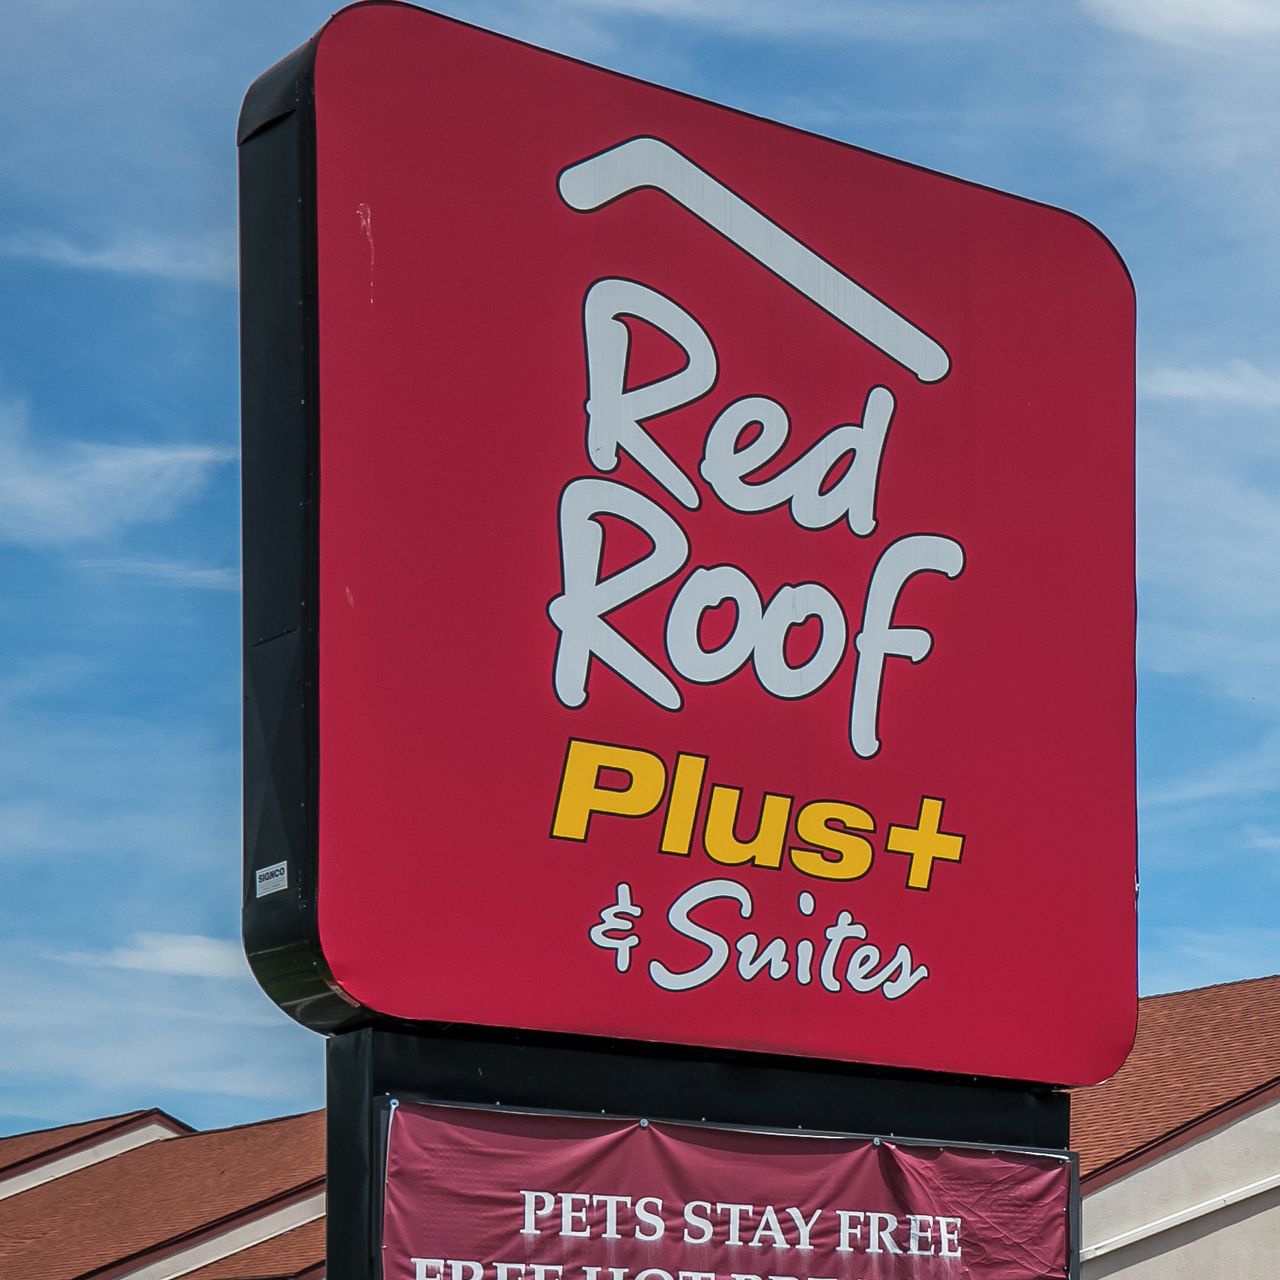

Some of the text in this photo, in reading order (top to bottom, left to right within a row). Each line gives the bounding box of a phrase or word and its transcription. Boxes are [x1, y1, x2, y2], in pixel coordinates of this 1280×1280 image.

[584, 278, 894, 536] Red
[548, 478, 965, 758] Roof
[258, 867, 285, 883] SIGNCO
[550, 738, 965, 893] Plus+
[589, 878, 930, 1000] & Suites
[519, 1190, 964, 1258] PETS STAY FREE
